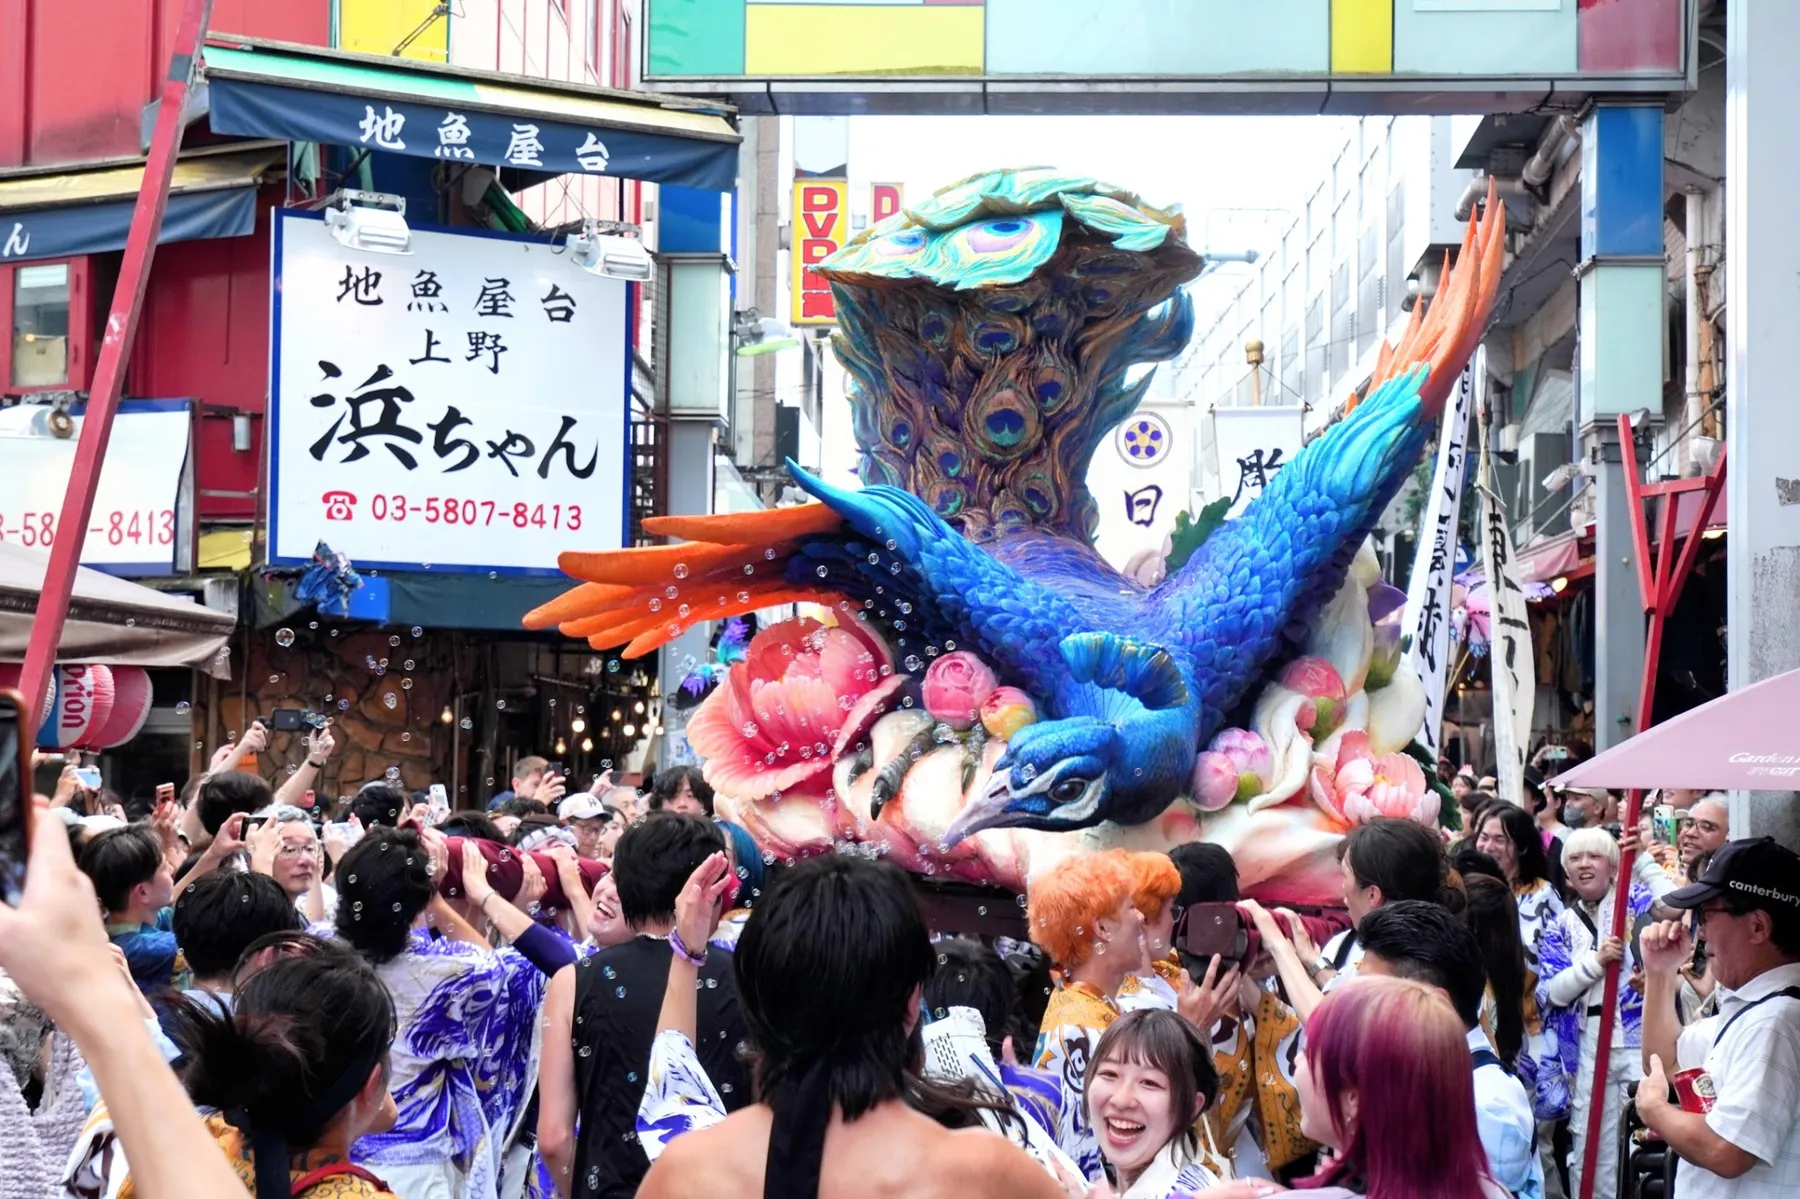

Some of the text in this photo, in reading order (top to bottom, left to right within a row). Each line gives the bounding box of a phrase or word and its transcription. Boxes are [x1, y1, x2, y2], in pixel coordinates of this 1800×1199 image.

[359, 105, 609, 172] 地魚屋台
[3, 223, 30, 257] ん
[337, 265, 576, 323] 地魚屋台
[409, 329, 508, 374] 上野
[309, 360, 598, 480] 浜ちゃん
[372, 494, 582, 530] 03-5807-8413
[1729, 880, 1800, 907] canterbury
